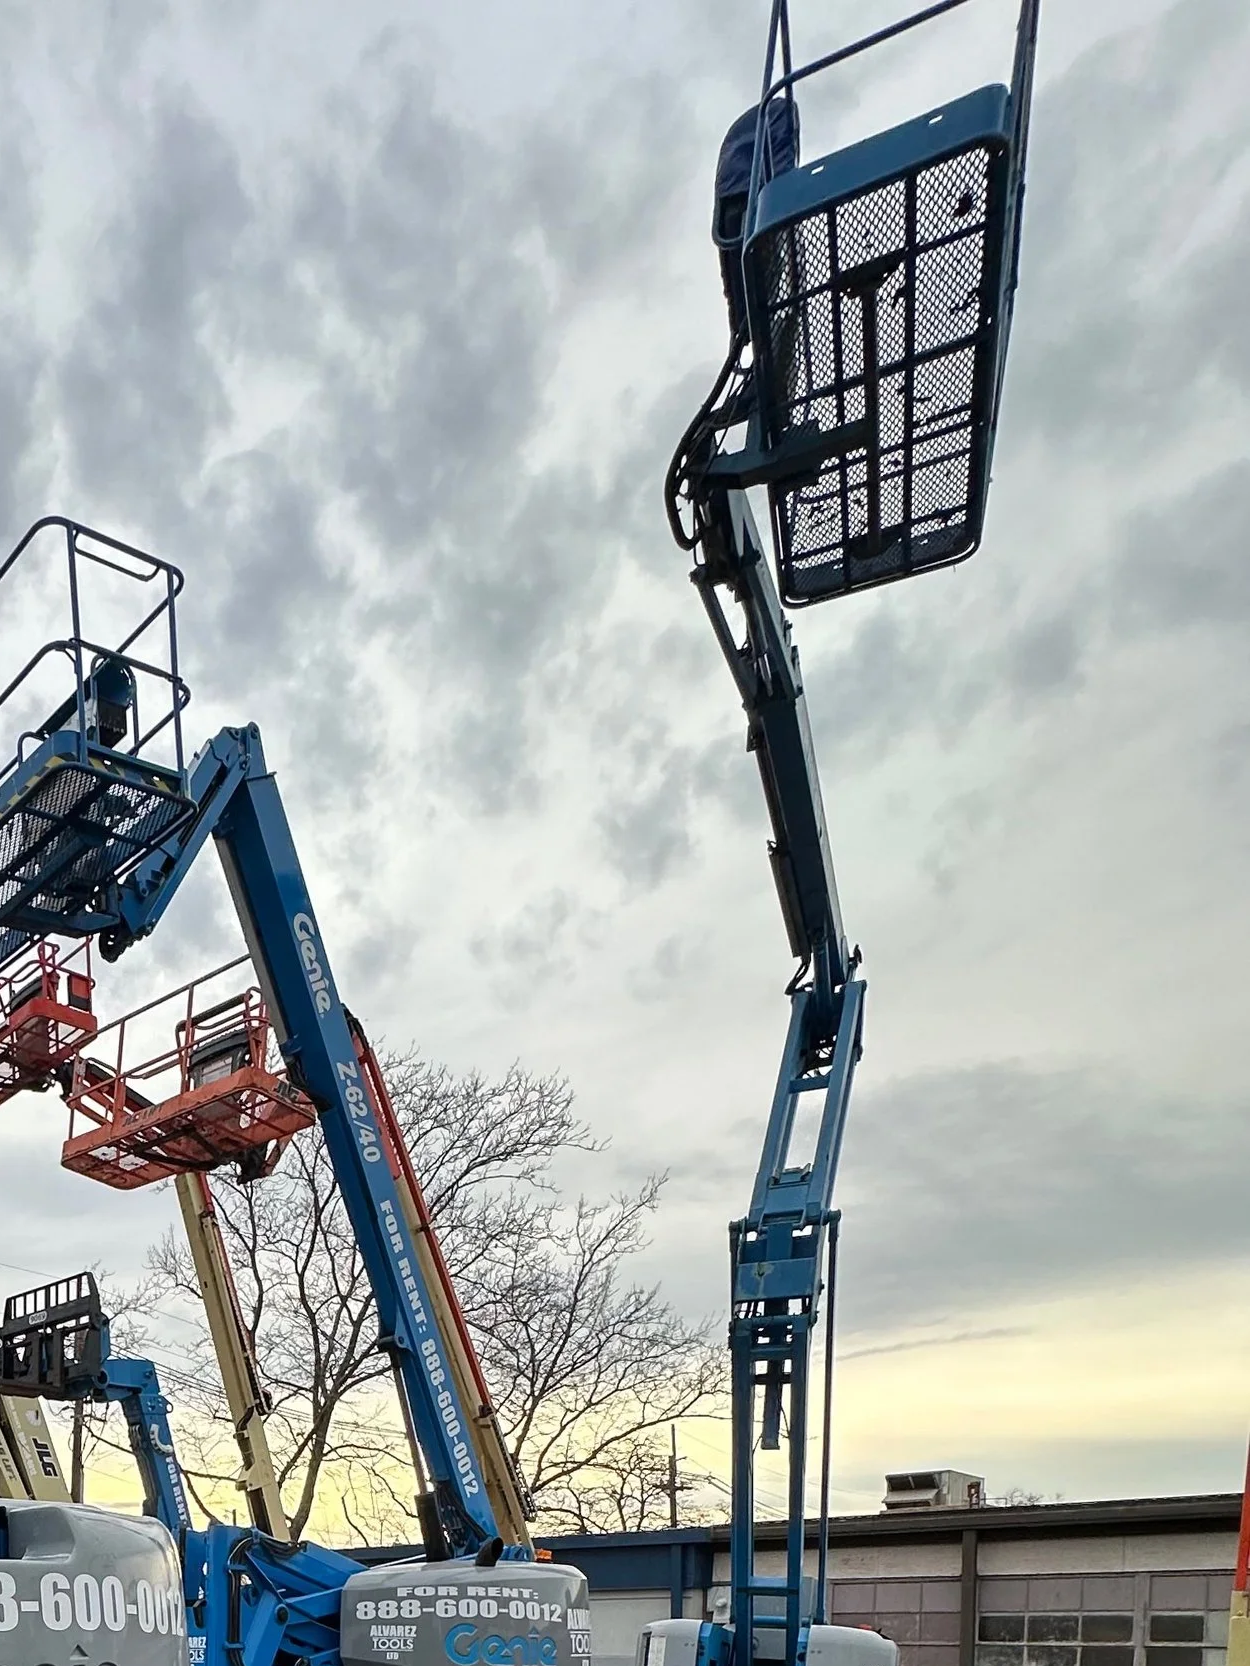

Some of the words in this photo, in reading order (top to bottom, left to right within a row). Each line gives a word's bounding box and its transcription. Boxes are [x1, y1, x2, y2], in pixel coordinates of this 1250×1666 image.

[293, 912, 331, 1014] Genie
[336, 1060, 381, 1163] Z-62/40
[379, 1199, 404, 1254] FOR
[398, 1256, 428, 1334] RENT:
[421, 1338, 479, 1498] 888-600-0012
[32, 1437, 58, 1477] JLG
[397, 1586, 459, 1597] FOR
[467, 1586, 539, 1599] RENT:
[356, 1599, 562, 1622] 888-600-0012
[370, 1625, 417, 1637] ALVAREZ
[372, 1638, 414, 1650] TOOLS
